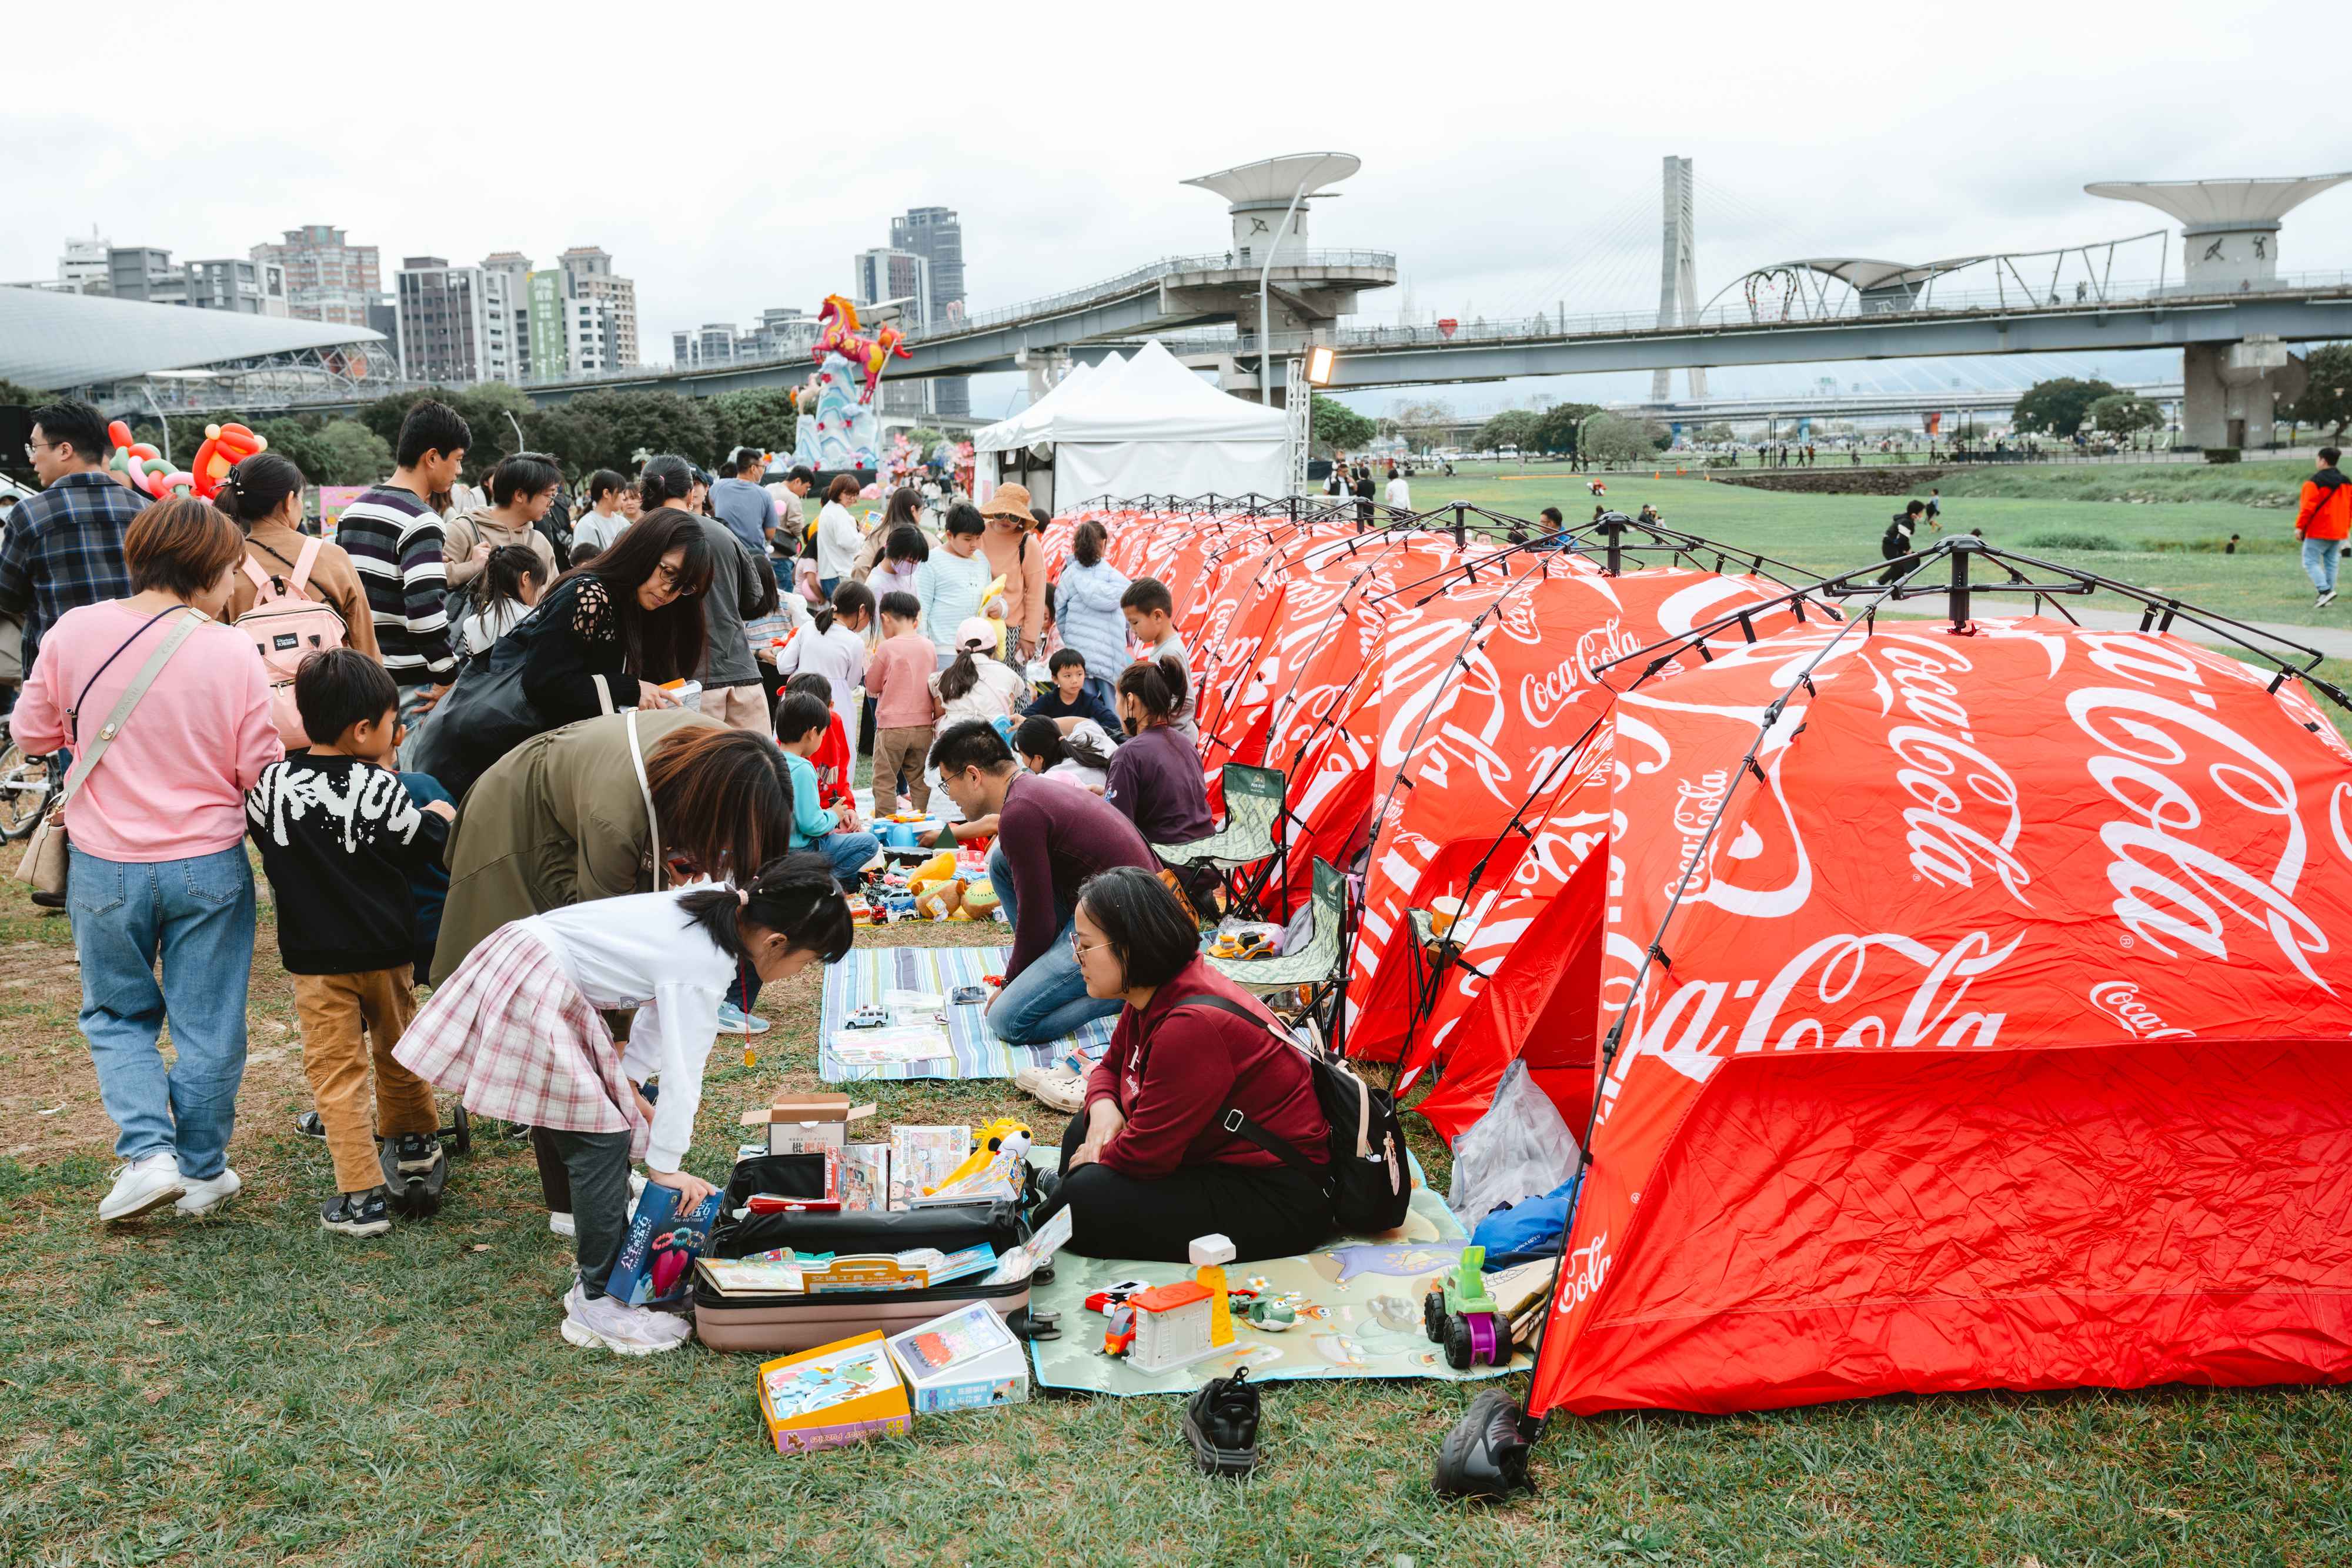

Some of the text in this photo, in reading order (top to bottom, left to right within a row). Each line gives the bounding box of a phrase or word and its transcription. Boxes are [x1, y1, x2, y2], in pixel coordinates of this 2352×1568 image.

[162, 623, 189, 654] COACH
[1520, 614, 1641, 728] Coca-Cola
[1858, 633, 2036, 909] Coca-Cola
[2066, 634, 2342, 998] a-Cola
[809, 1432, 843, 1444] Puzzles
